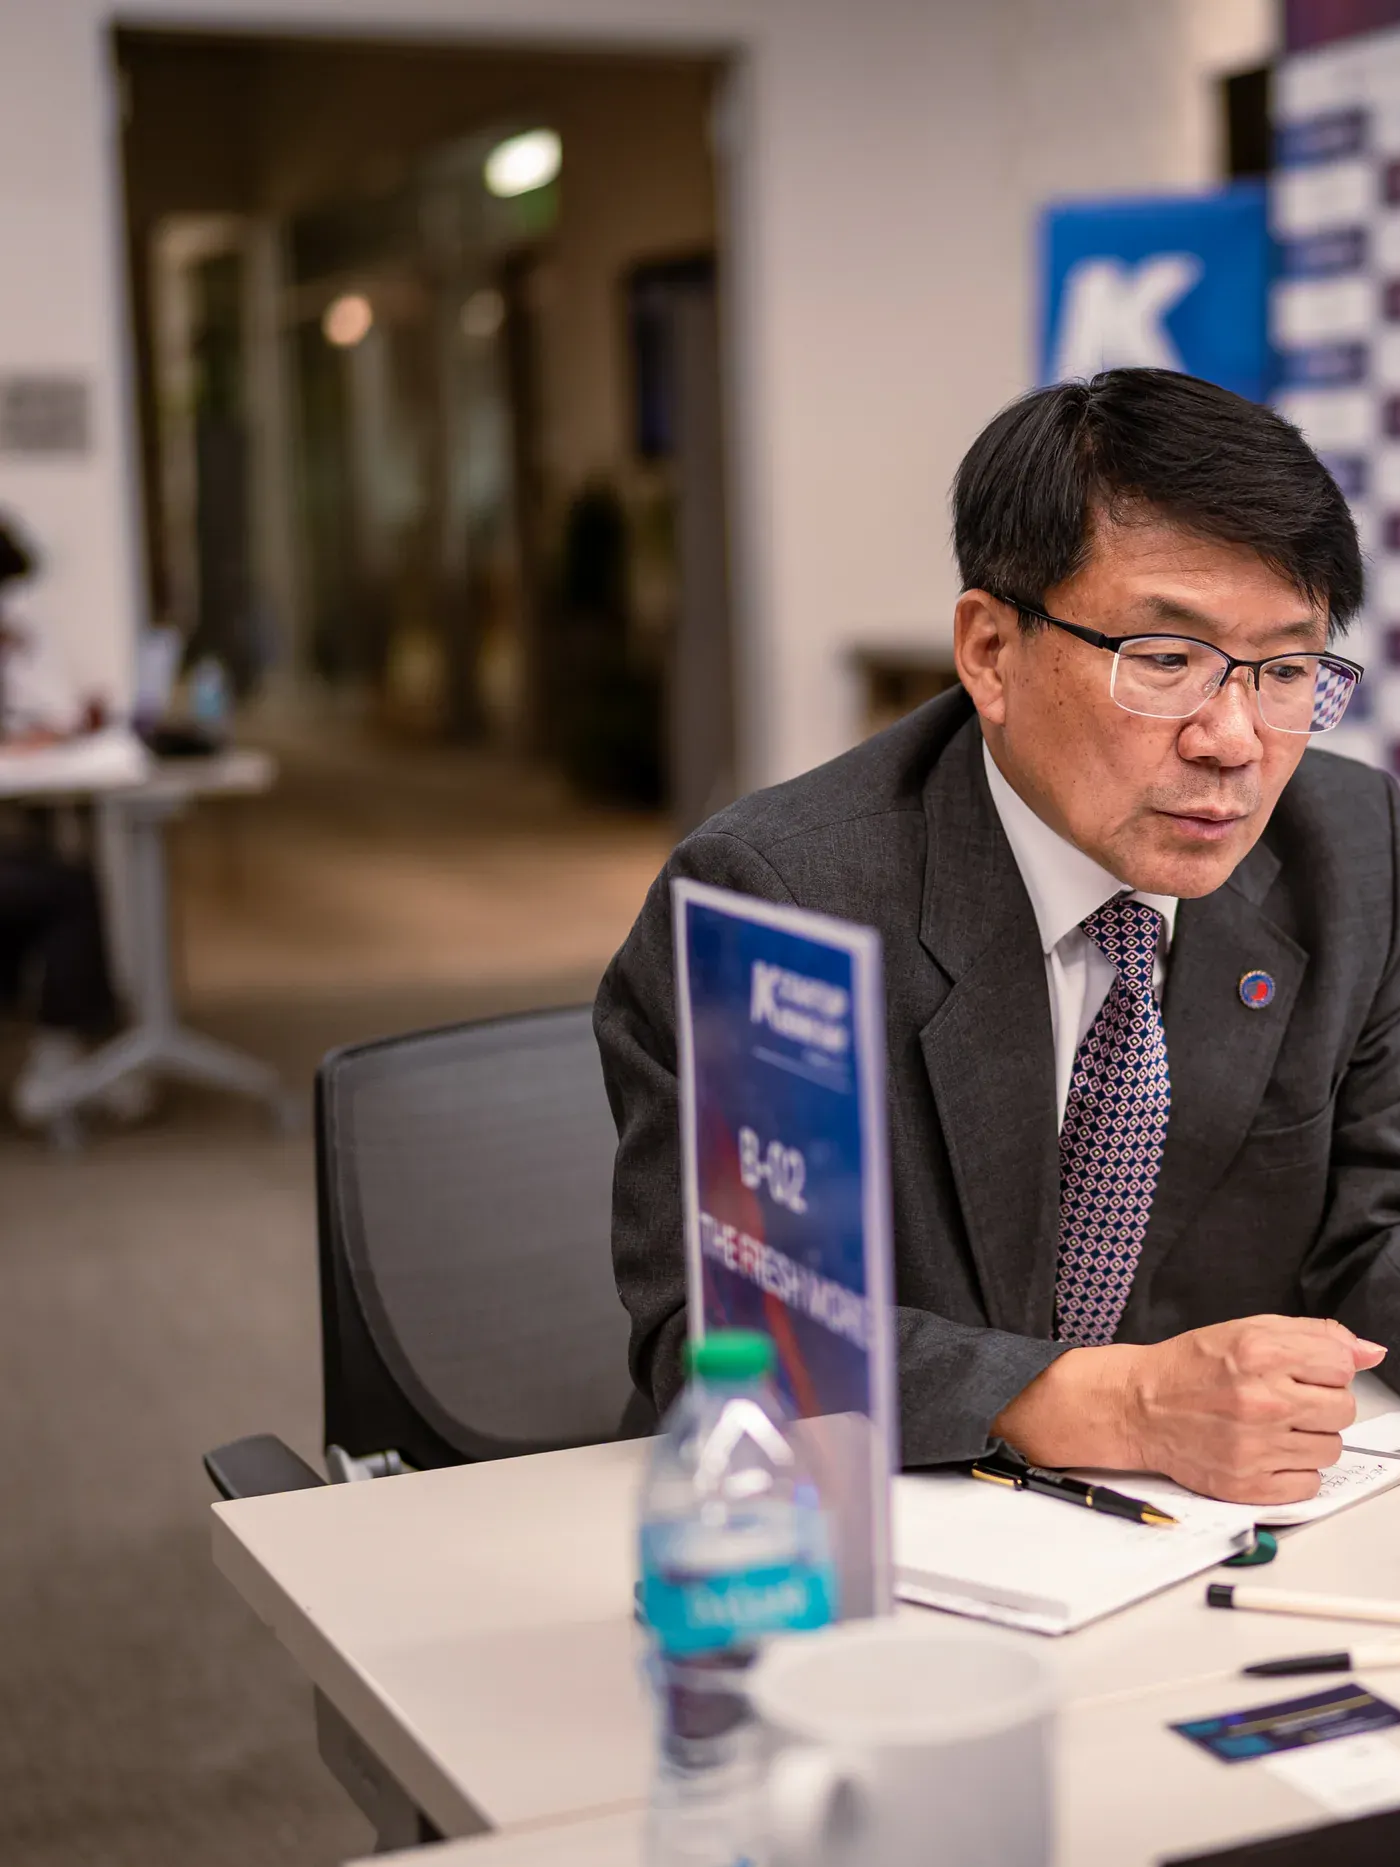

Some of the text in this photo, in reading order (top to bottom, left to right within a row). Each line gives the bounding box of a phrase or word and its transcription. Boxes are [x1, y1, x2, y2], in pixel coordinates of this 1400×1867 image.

[739, 1126, 808, 1215] B-02
[699, 1211, 741, 1272] THE
[740, 1232, 809, 1311] FRESH
